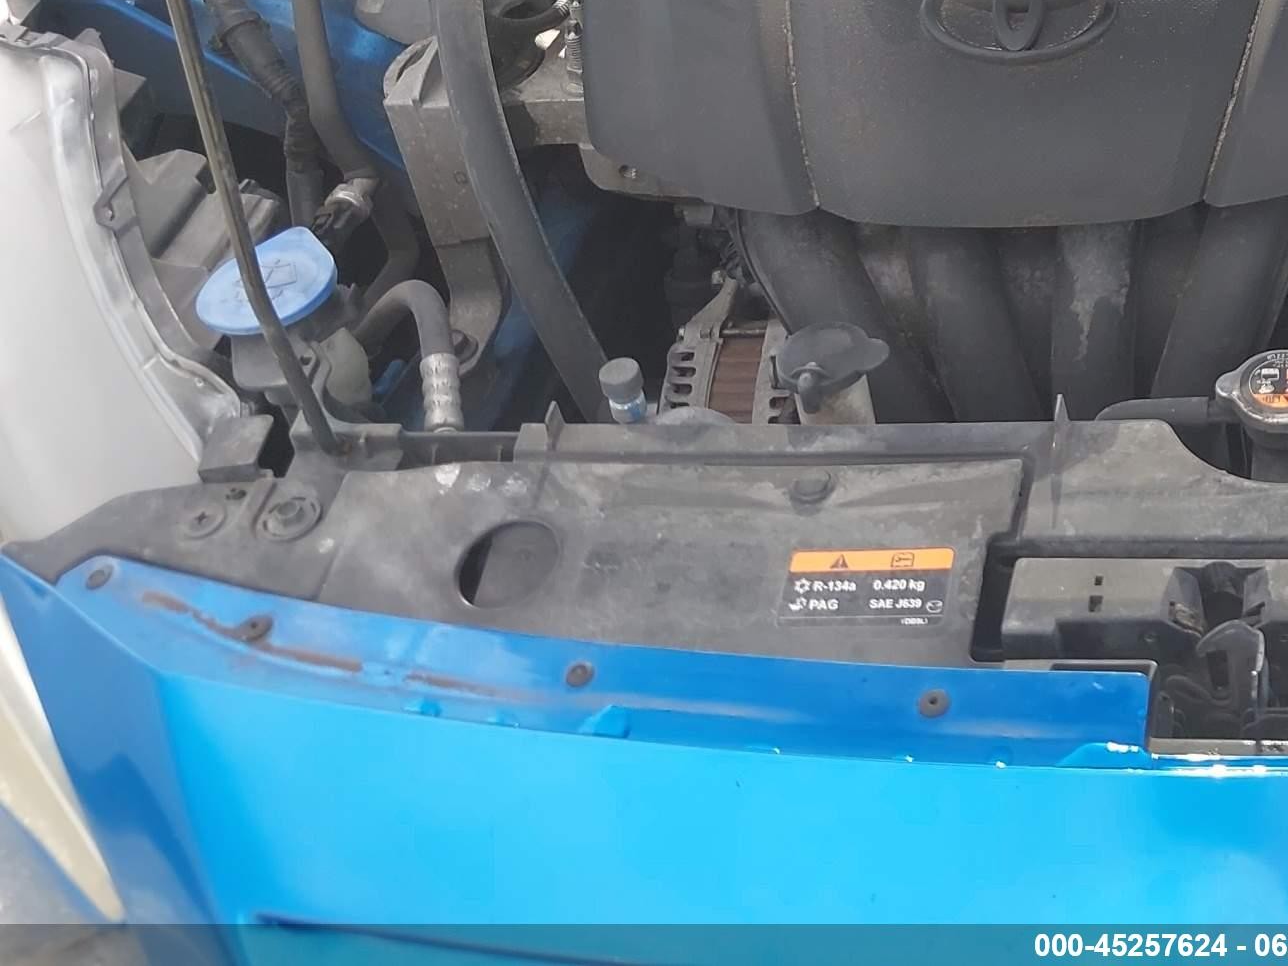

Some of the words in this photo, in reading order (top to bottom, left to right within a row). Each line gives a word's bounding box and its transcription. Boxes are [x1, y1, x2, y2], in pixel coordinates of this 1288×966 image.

[813, 580, 856, 592] R-134a
[873, 579, 906, 591] 0.420
[909, 579, 925, 592] kg
[808, 599, 839, 611] PAG
[869, 598, 893, 609] SAE
[895, 598, 922, 609] J639
